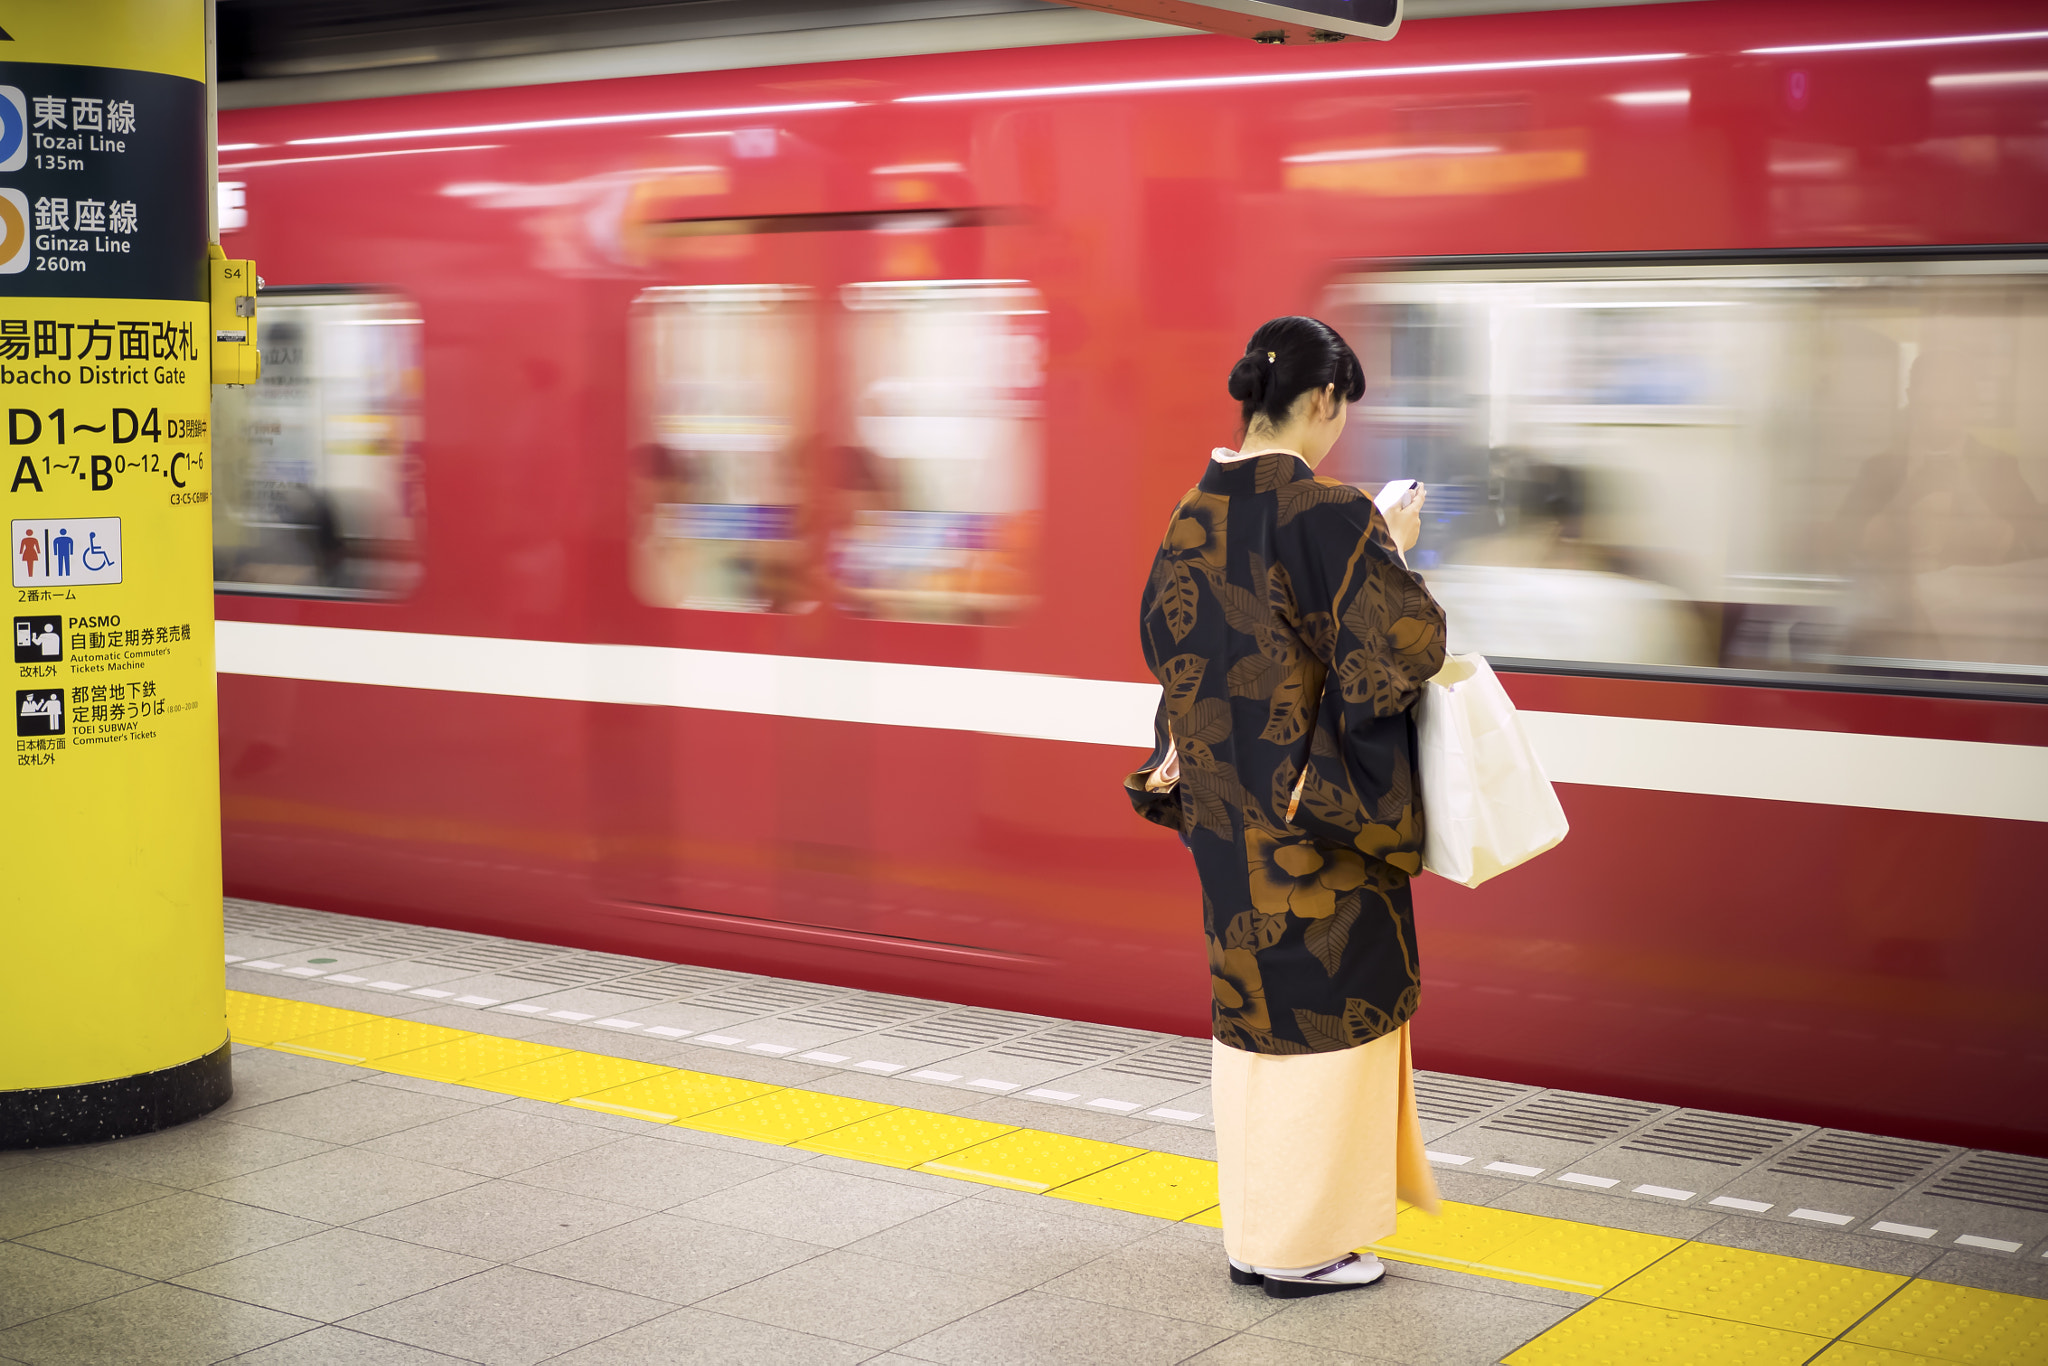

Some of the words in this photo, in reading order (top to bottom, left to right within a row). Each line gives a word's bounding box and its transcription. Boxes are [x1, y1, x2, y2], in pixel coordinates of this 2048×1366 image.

[32, 95, 137, 134] 東西線
[32, 132, 83, 151] Tozai
[90, 135, 126, 153] Line
[34, 155, 84, 171] 135m
[34, 196, 139, 234] 銀座線
[35, 234, 89, 252] Ginza
[95, 236, 131, 253] Line
[36, 256, 87, 272] 260m
[224, 268, 242, 280] S4
[1, 364, 71, 385] bacho
[80, 365, 149, 385] District
[154, 366, 186, 385] Gate
[18, 589, 77, 603] 2番ホーム
[69, 615, 121, 629] PASMO
[71, 623, 191, 651] 自動定期券発売機
[70, 651, 121, 663] Automatic
[124, 647, 171, 660] Commuter's
[19, 665, 58, 678] 改札外
[70, 663, 105, 674] Tickets
[107, 661, 145, 672] Machine
[71, 680, 157, 704] 都営地下鉄
[72, 698, 166, 724] 定期券うりば
[72, 725, 96, 736] TOEI
[98, 721, 139, 734] SUBWAY
[16, 738, 66, 752] 日本橋方面
[72, 734, 128, 746] Commuter's
[129, 730, 157, 741] Tickets
[17, 753, 56, 767] 改札外
